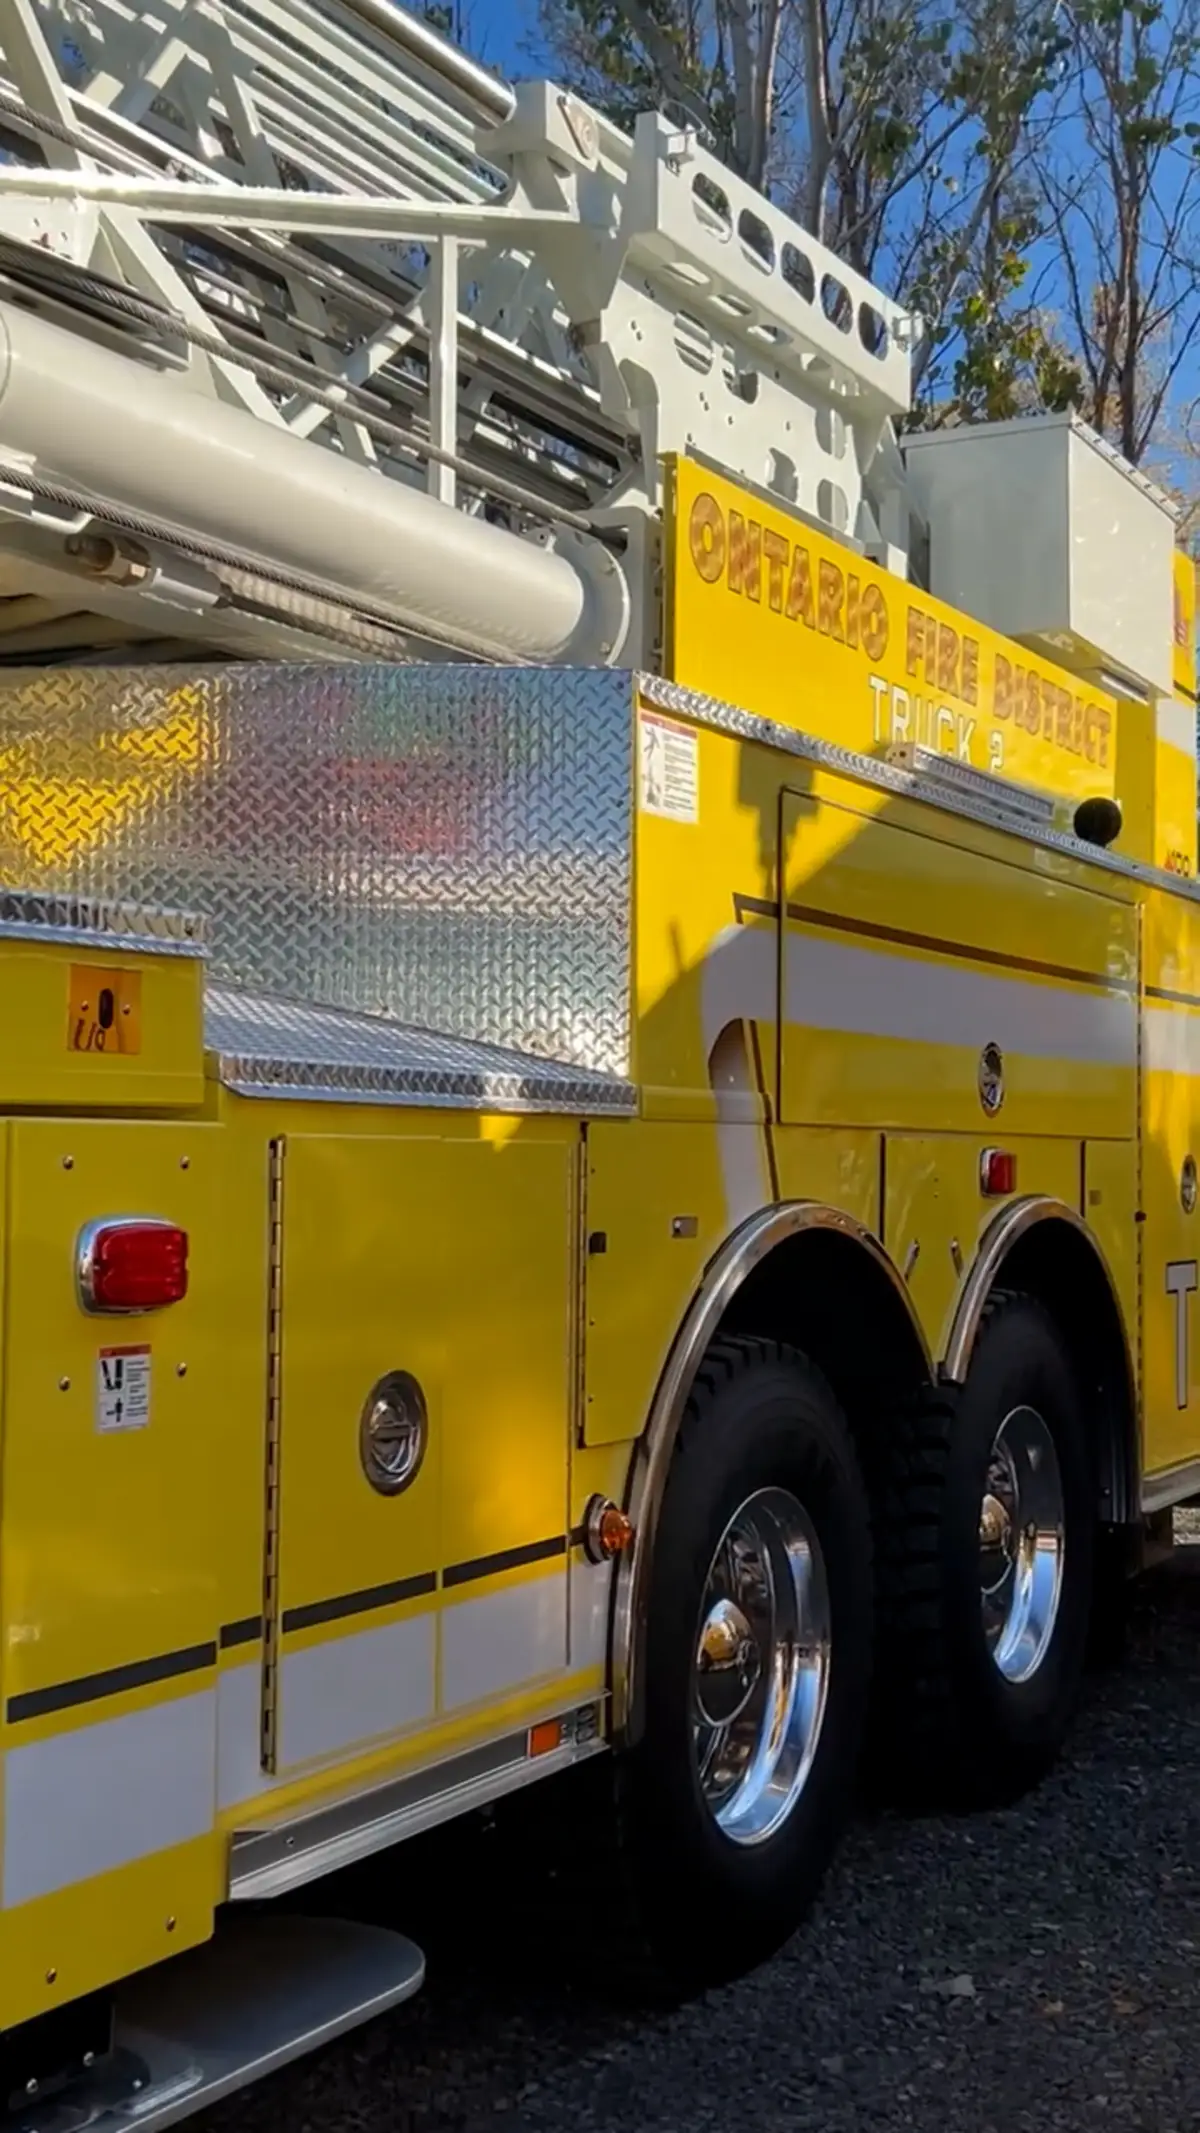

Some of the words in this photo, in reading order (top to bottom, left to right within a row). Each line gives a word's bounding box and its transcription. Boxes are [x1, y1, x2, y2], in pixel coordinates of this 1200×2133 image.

[689, 491, 889, 663] ONTARIO
[906, 604, 980, 708] FIRE
[992, 652, 1112, 769] DISTRICT
[868, 672, 977, 766] TRUCK
